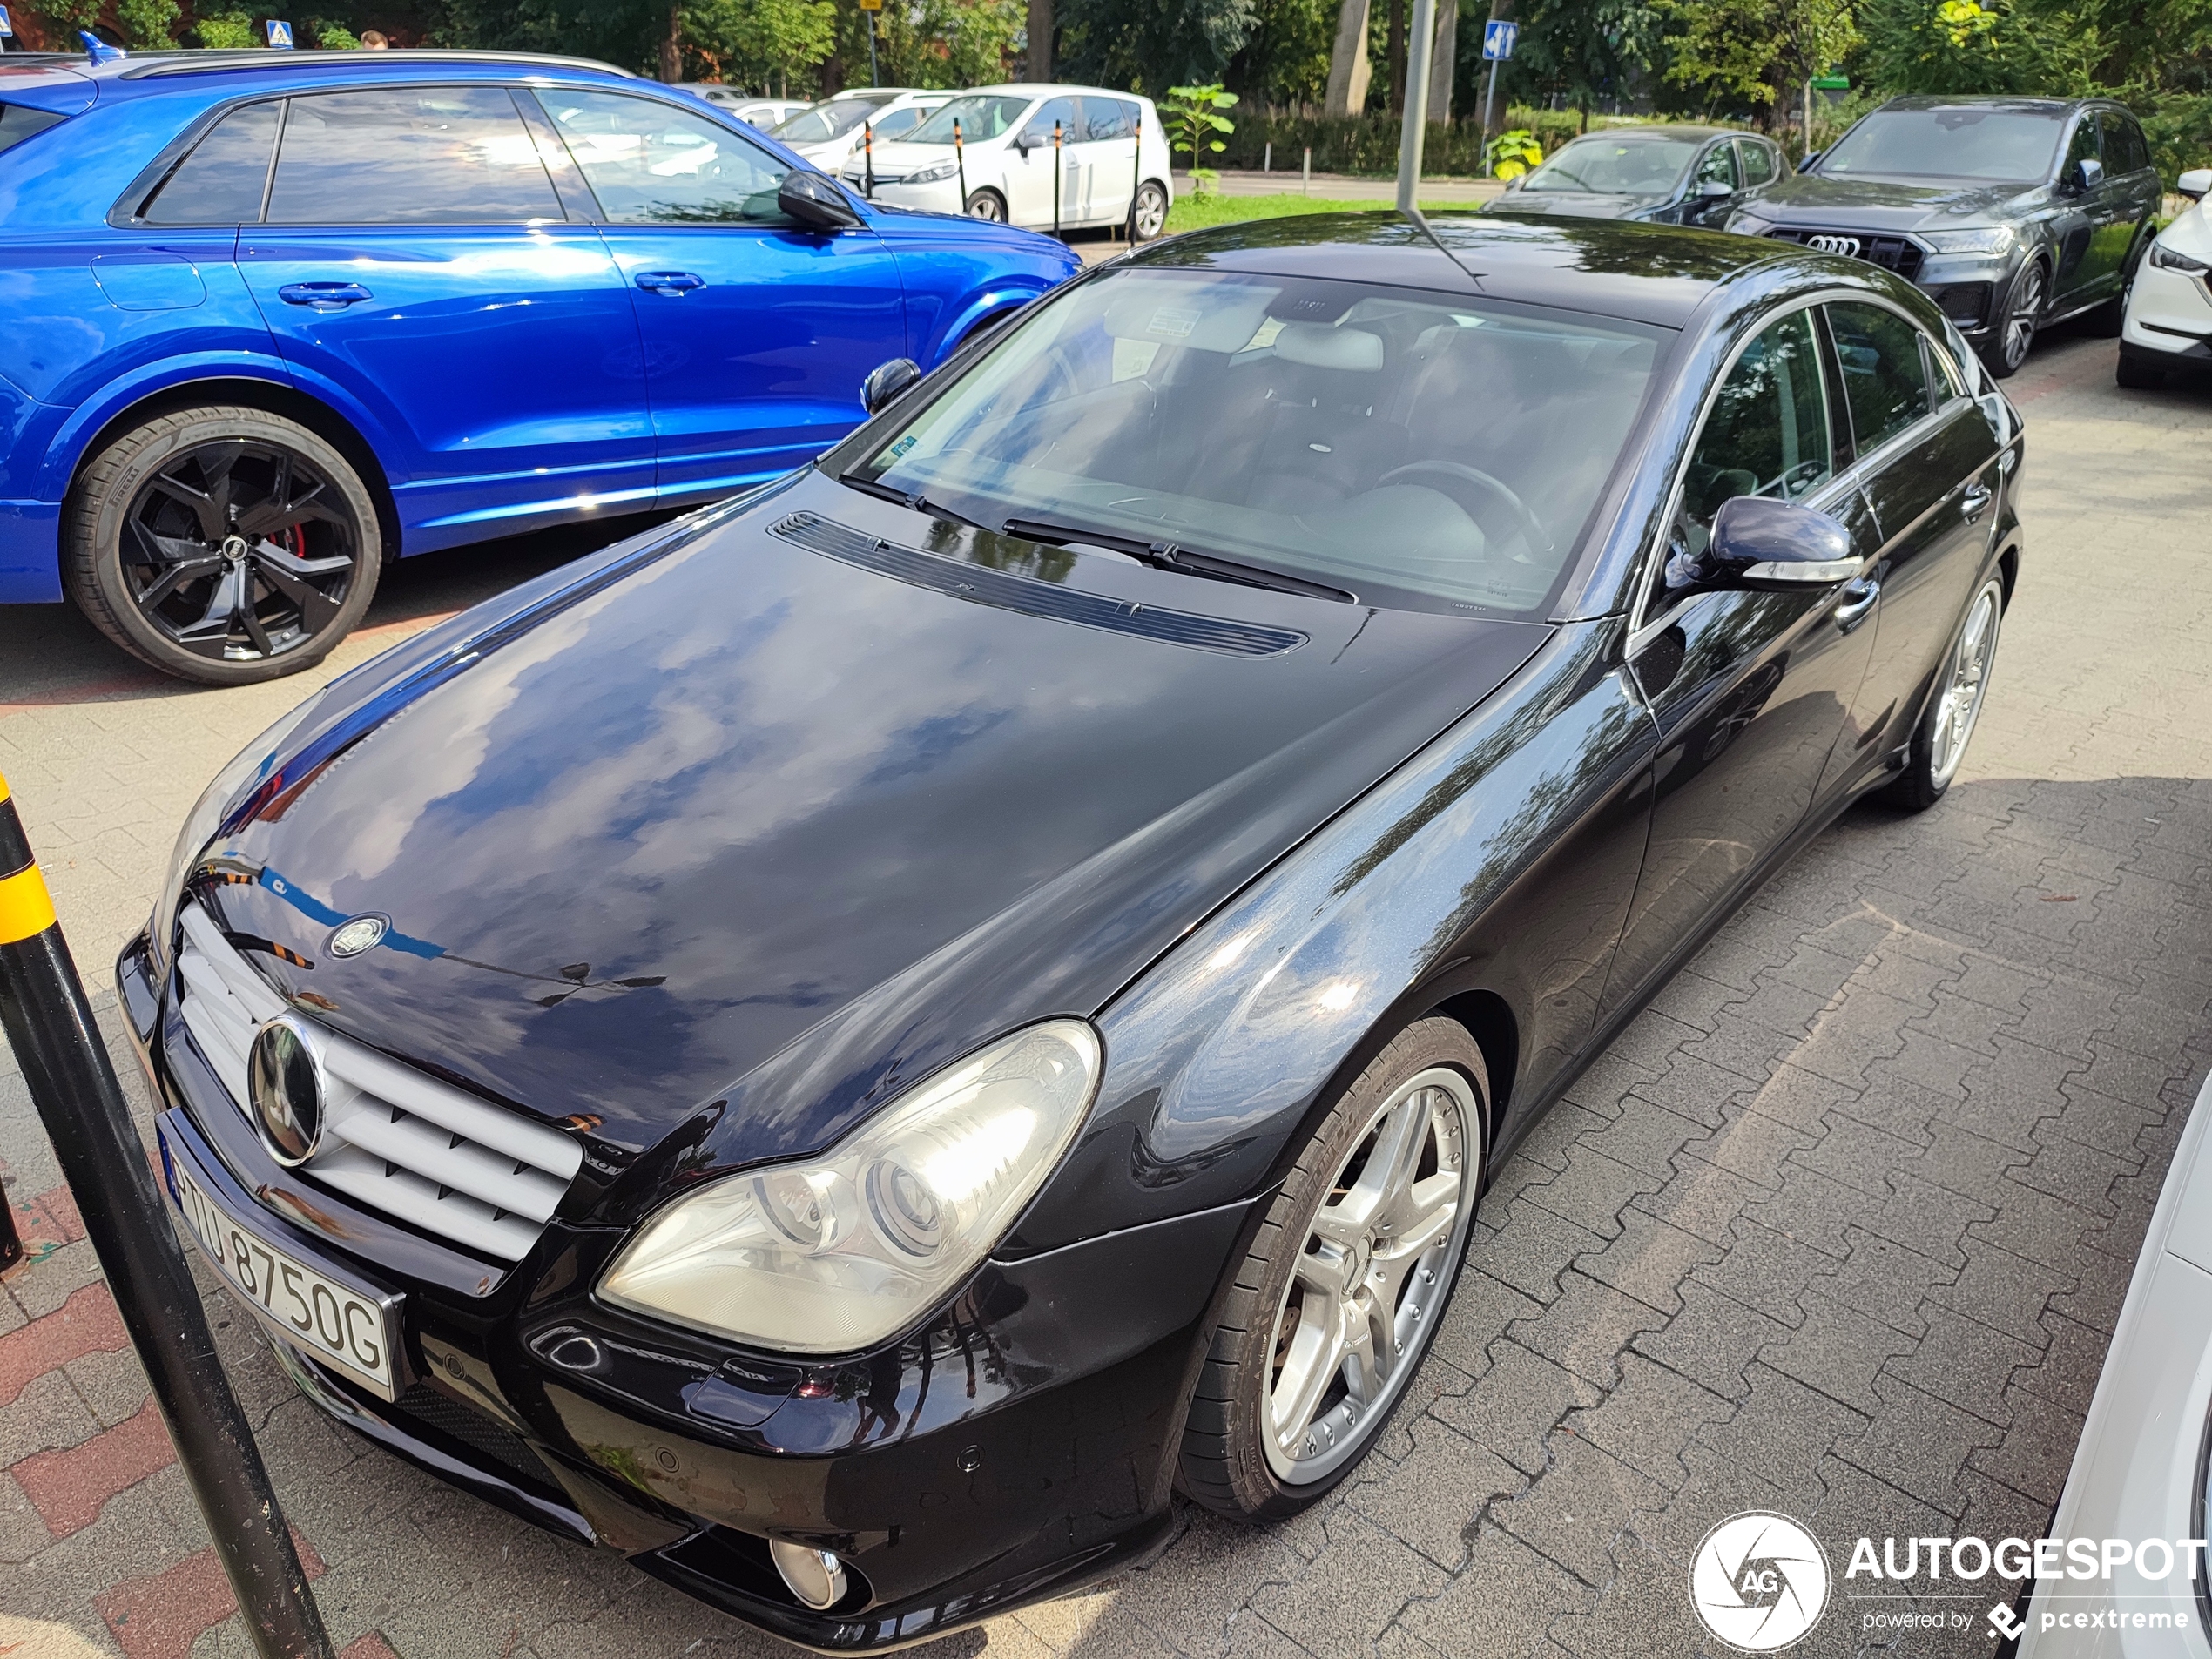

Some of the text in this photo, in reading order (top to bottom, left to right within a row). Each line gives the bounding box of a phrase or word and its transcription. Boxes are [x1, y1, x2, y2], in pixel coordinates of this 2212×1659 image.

[108, 465, 140, 508] PIRELLI
[170, 1150, 381, 1370] PTU 8750G
